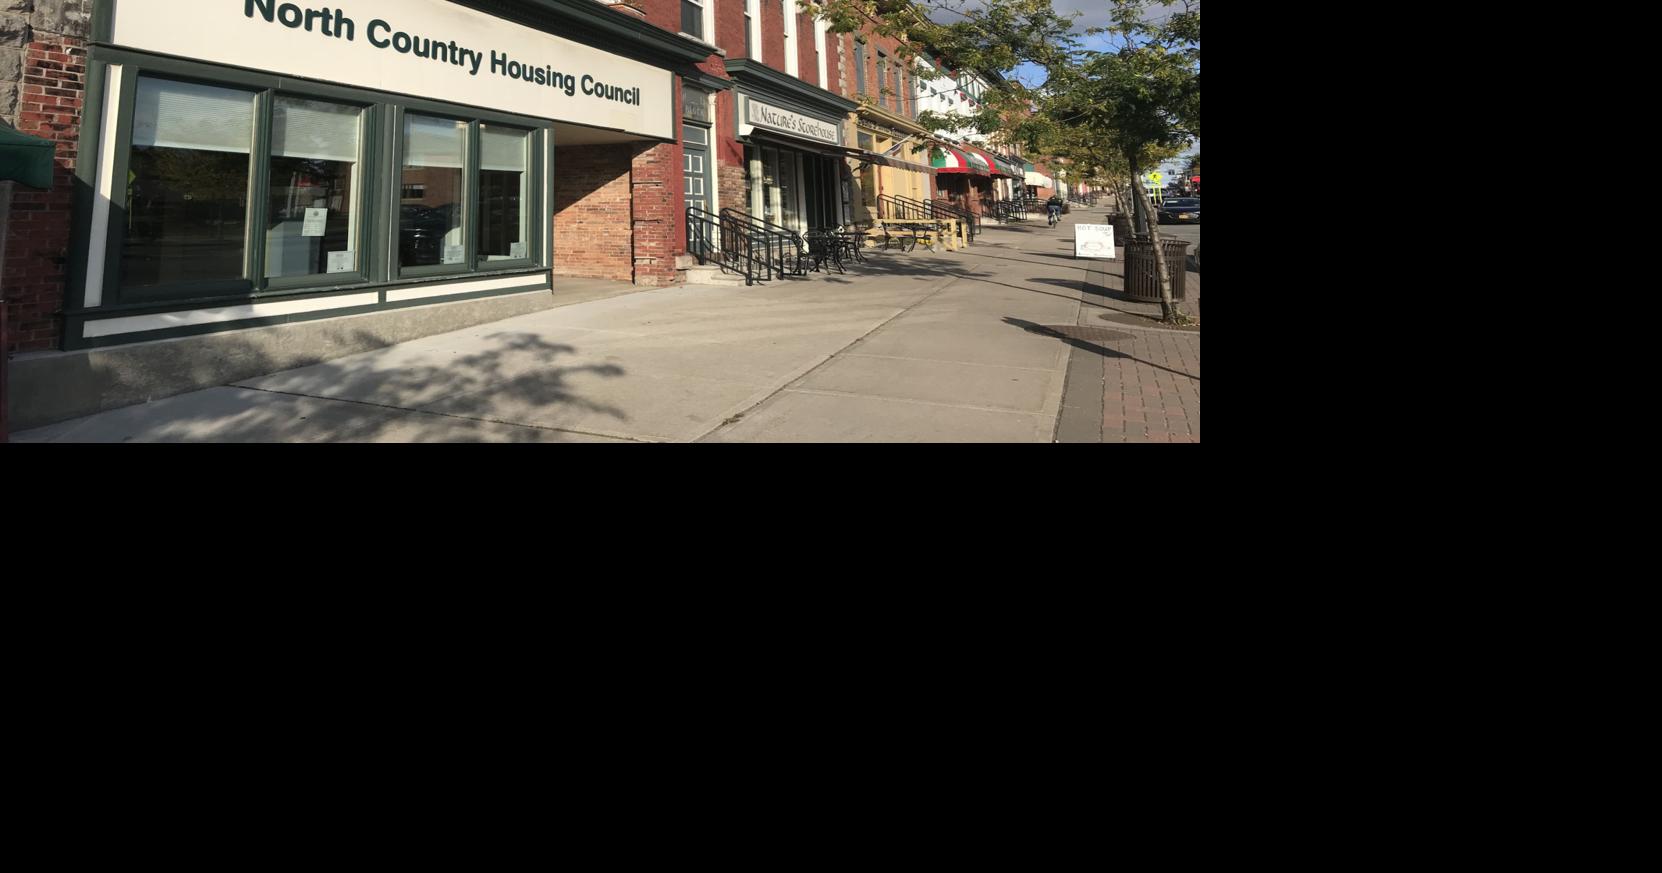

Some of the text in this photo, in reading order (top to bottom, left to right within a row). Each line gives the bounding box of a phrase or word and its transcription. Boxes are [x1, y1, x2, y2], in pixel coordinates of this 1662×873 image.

[244, 0, 640, 106] North Country Housing Council
